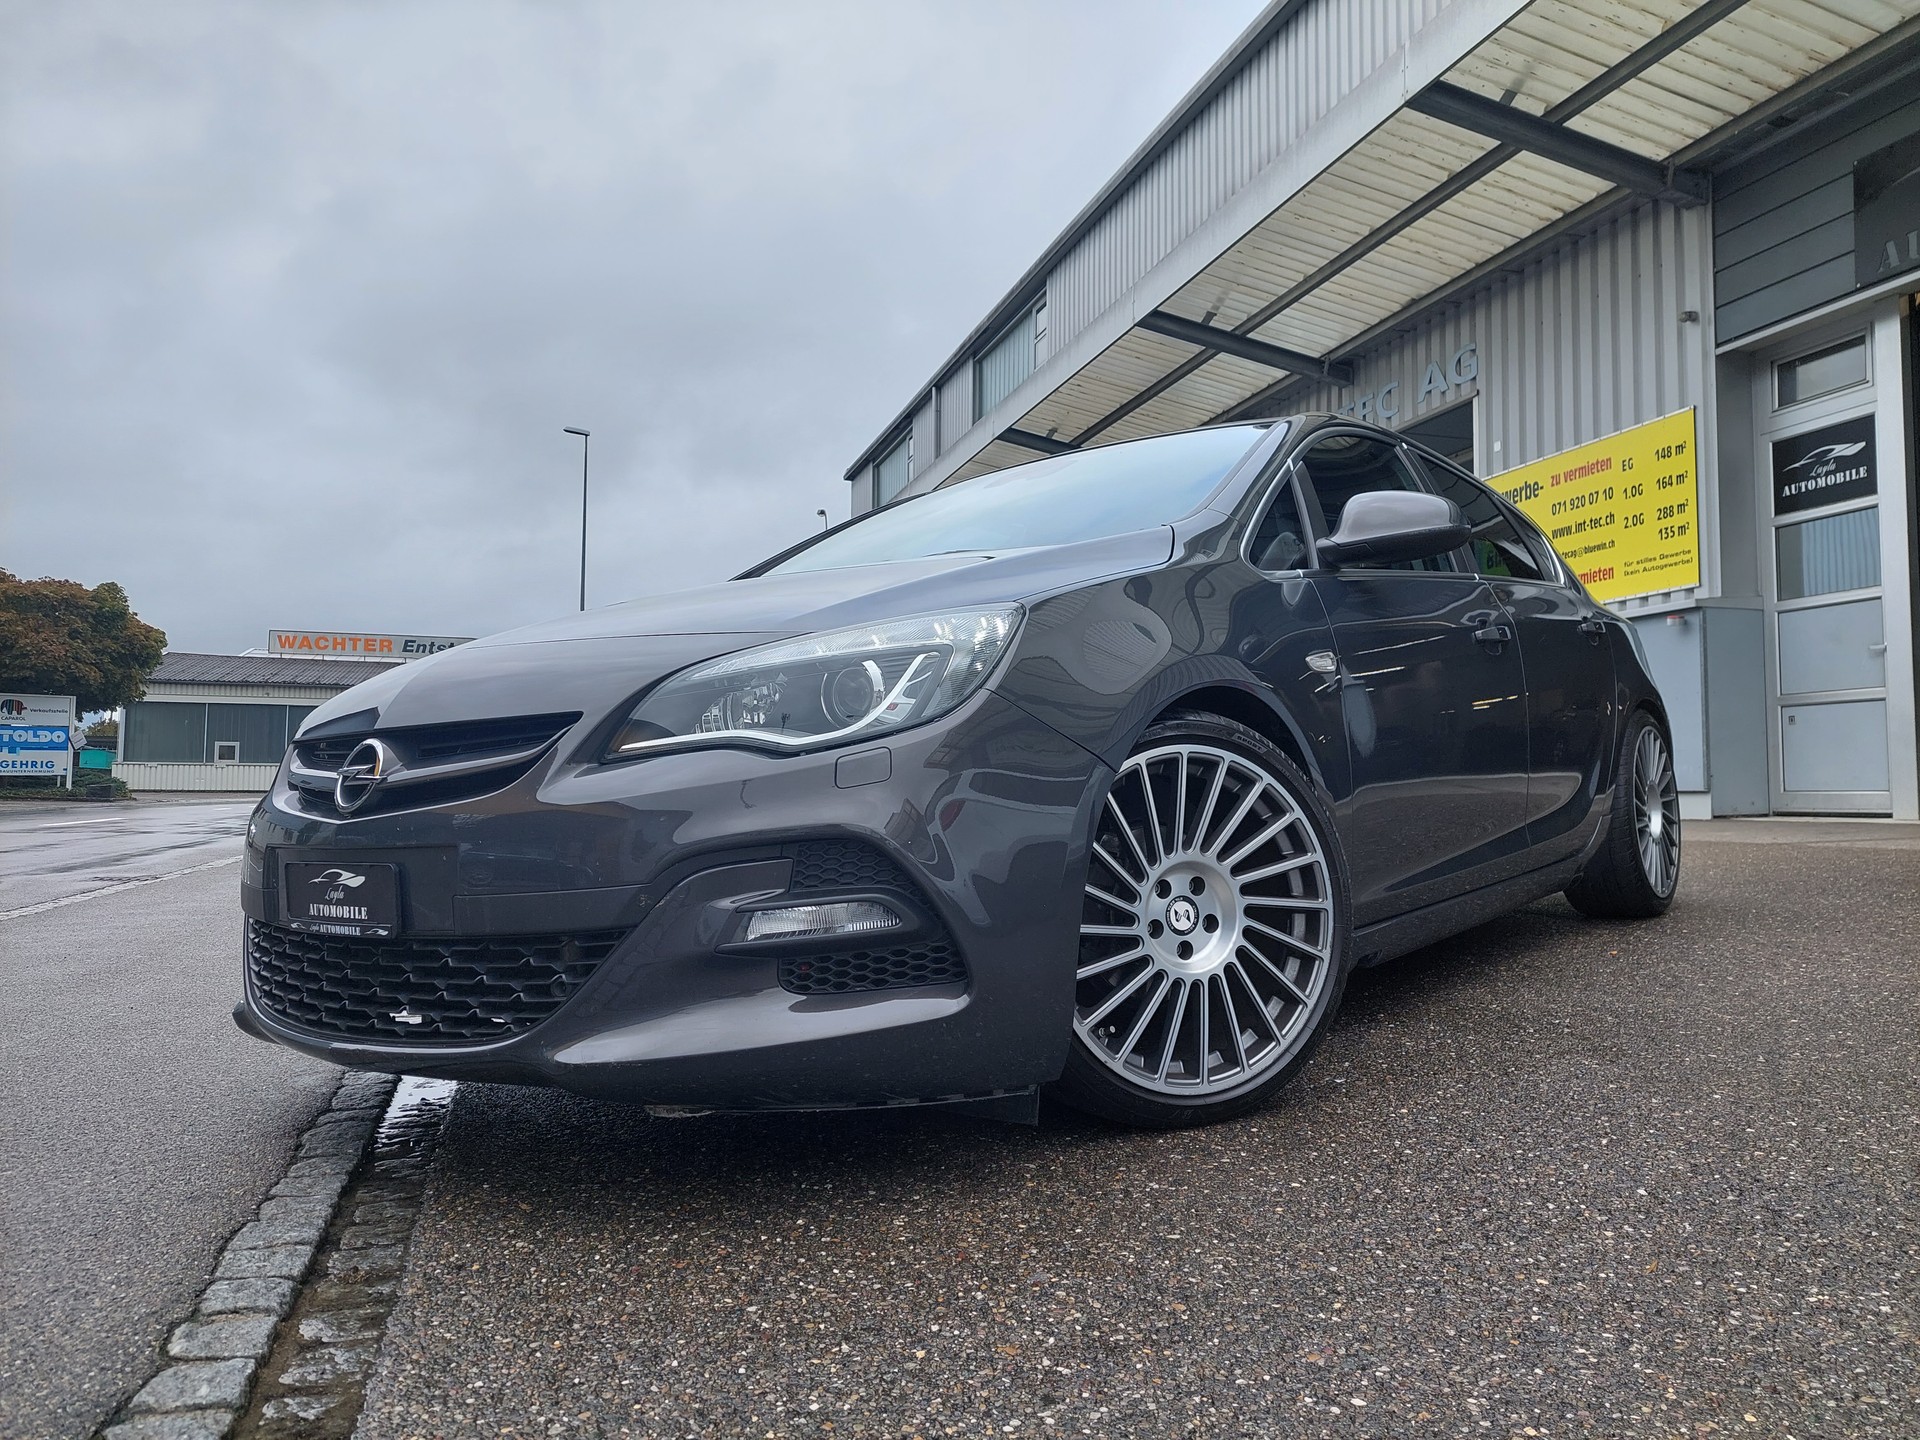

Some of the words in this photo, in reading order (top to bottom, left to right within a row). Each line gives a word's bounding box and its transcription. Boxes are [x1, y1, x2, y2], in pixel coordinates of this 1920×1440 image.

[1417, 341, 1478, 404] AG
[1550, 473, 1561, 488] zu
[1563, 456, 1612, 483] vermieten
[1621, 457, 1634, 472] EG
[1654, 445, 1673, 462] 148
[1782, 466, 1868, 498] AUTOMOBILE
[1551, 500, 1567, 516] 071
[1569, 495, 1586, 511] 920
[1588, 490, 1599, 505] 07
[1602, 486, 1614, 501] 10
[1656, 474, 1673, 490] 164
[1551, 511, 1615, 540] www.int-tec.ch
[1656, 504, 1675, 521] 288
[1658, 525, 1676, 541] 135
[1636, 556, 1657, 566] stilles
[277, 634, 393, 653] WACHTER
[1236, 735, 1263, 751] SPORT
[0, 760, 55, 769] GEHRIG
[324, 885, 345, 904] Layla
[308, 903, 368, 920] AUTOMOBILE
[319, 924, 361, 936] AUTOMOBILE
